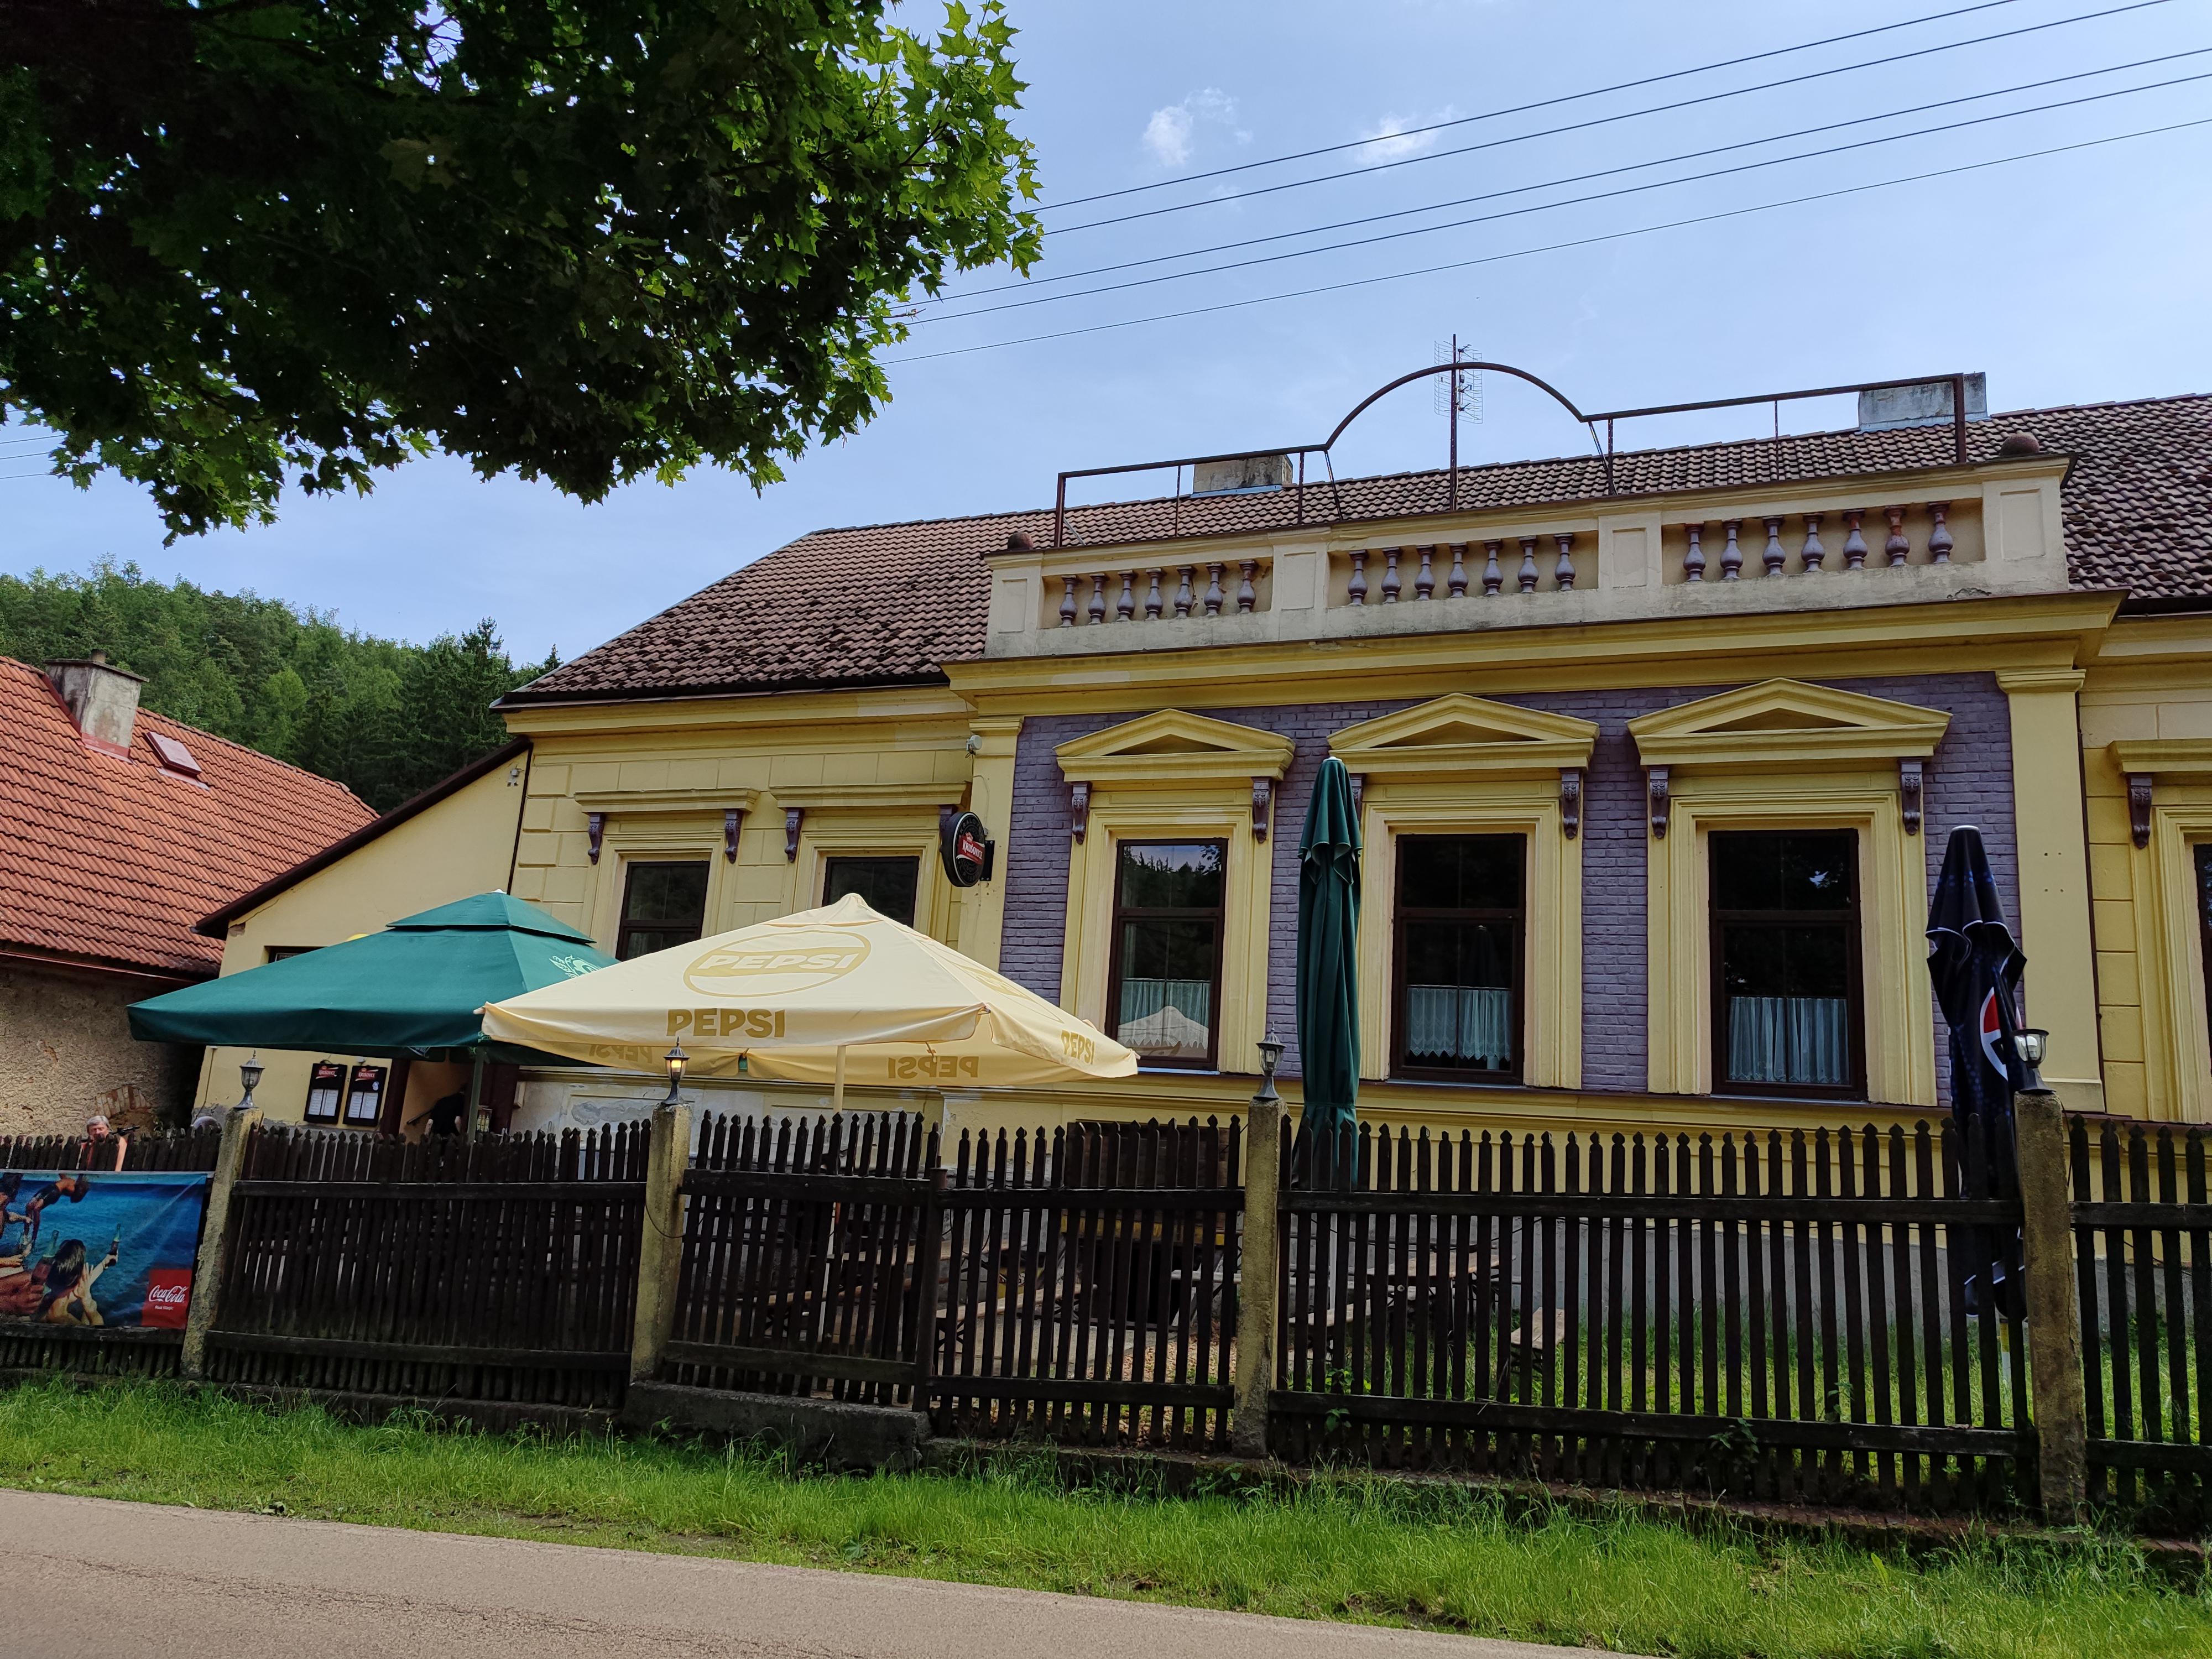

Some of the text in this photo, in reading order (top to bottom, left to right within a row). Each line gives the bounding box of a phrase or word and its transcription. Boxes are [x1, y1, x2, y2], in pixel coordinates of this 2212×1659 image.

[962, 839, 983, 860] KRUŠOVICE
[697, 953, 859, 969] PEPSI
[666, 1008, 785, 1038] PEPSI
[1061, 1030, 1095, 1065] PEPSI
